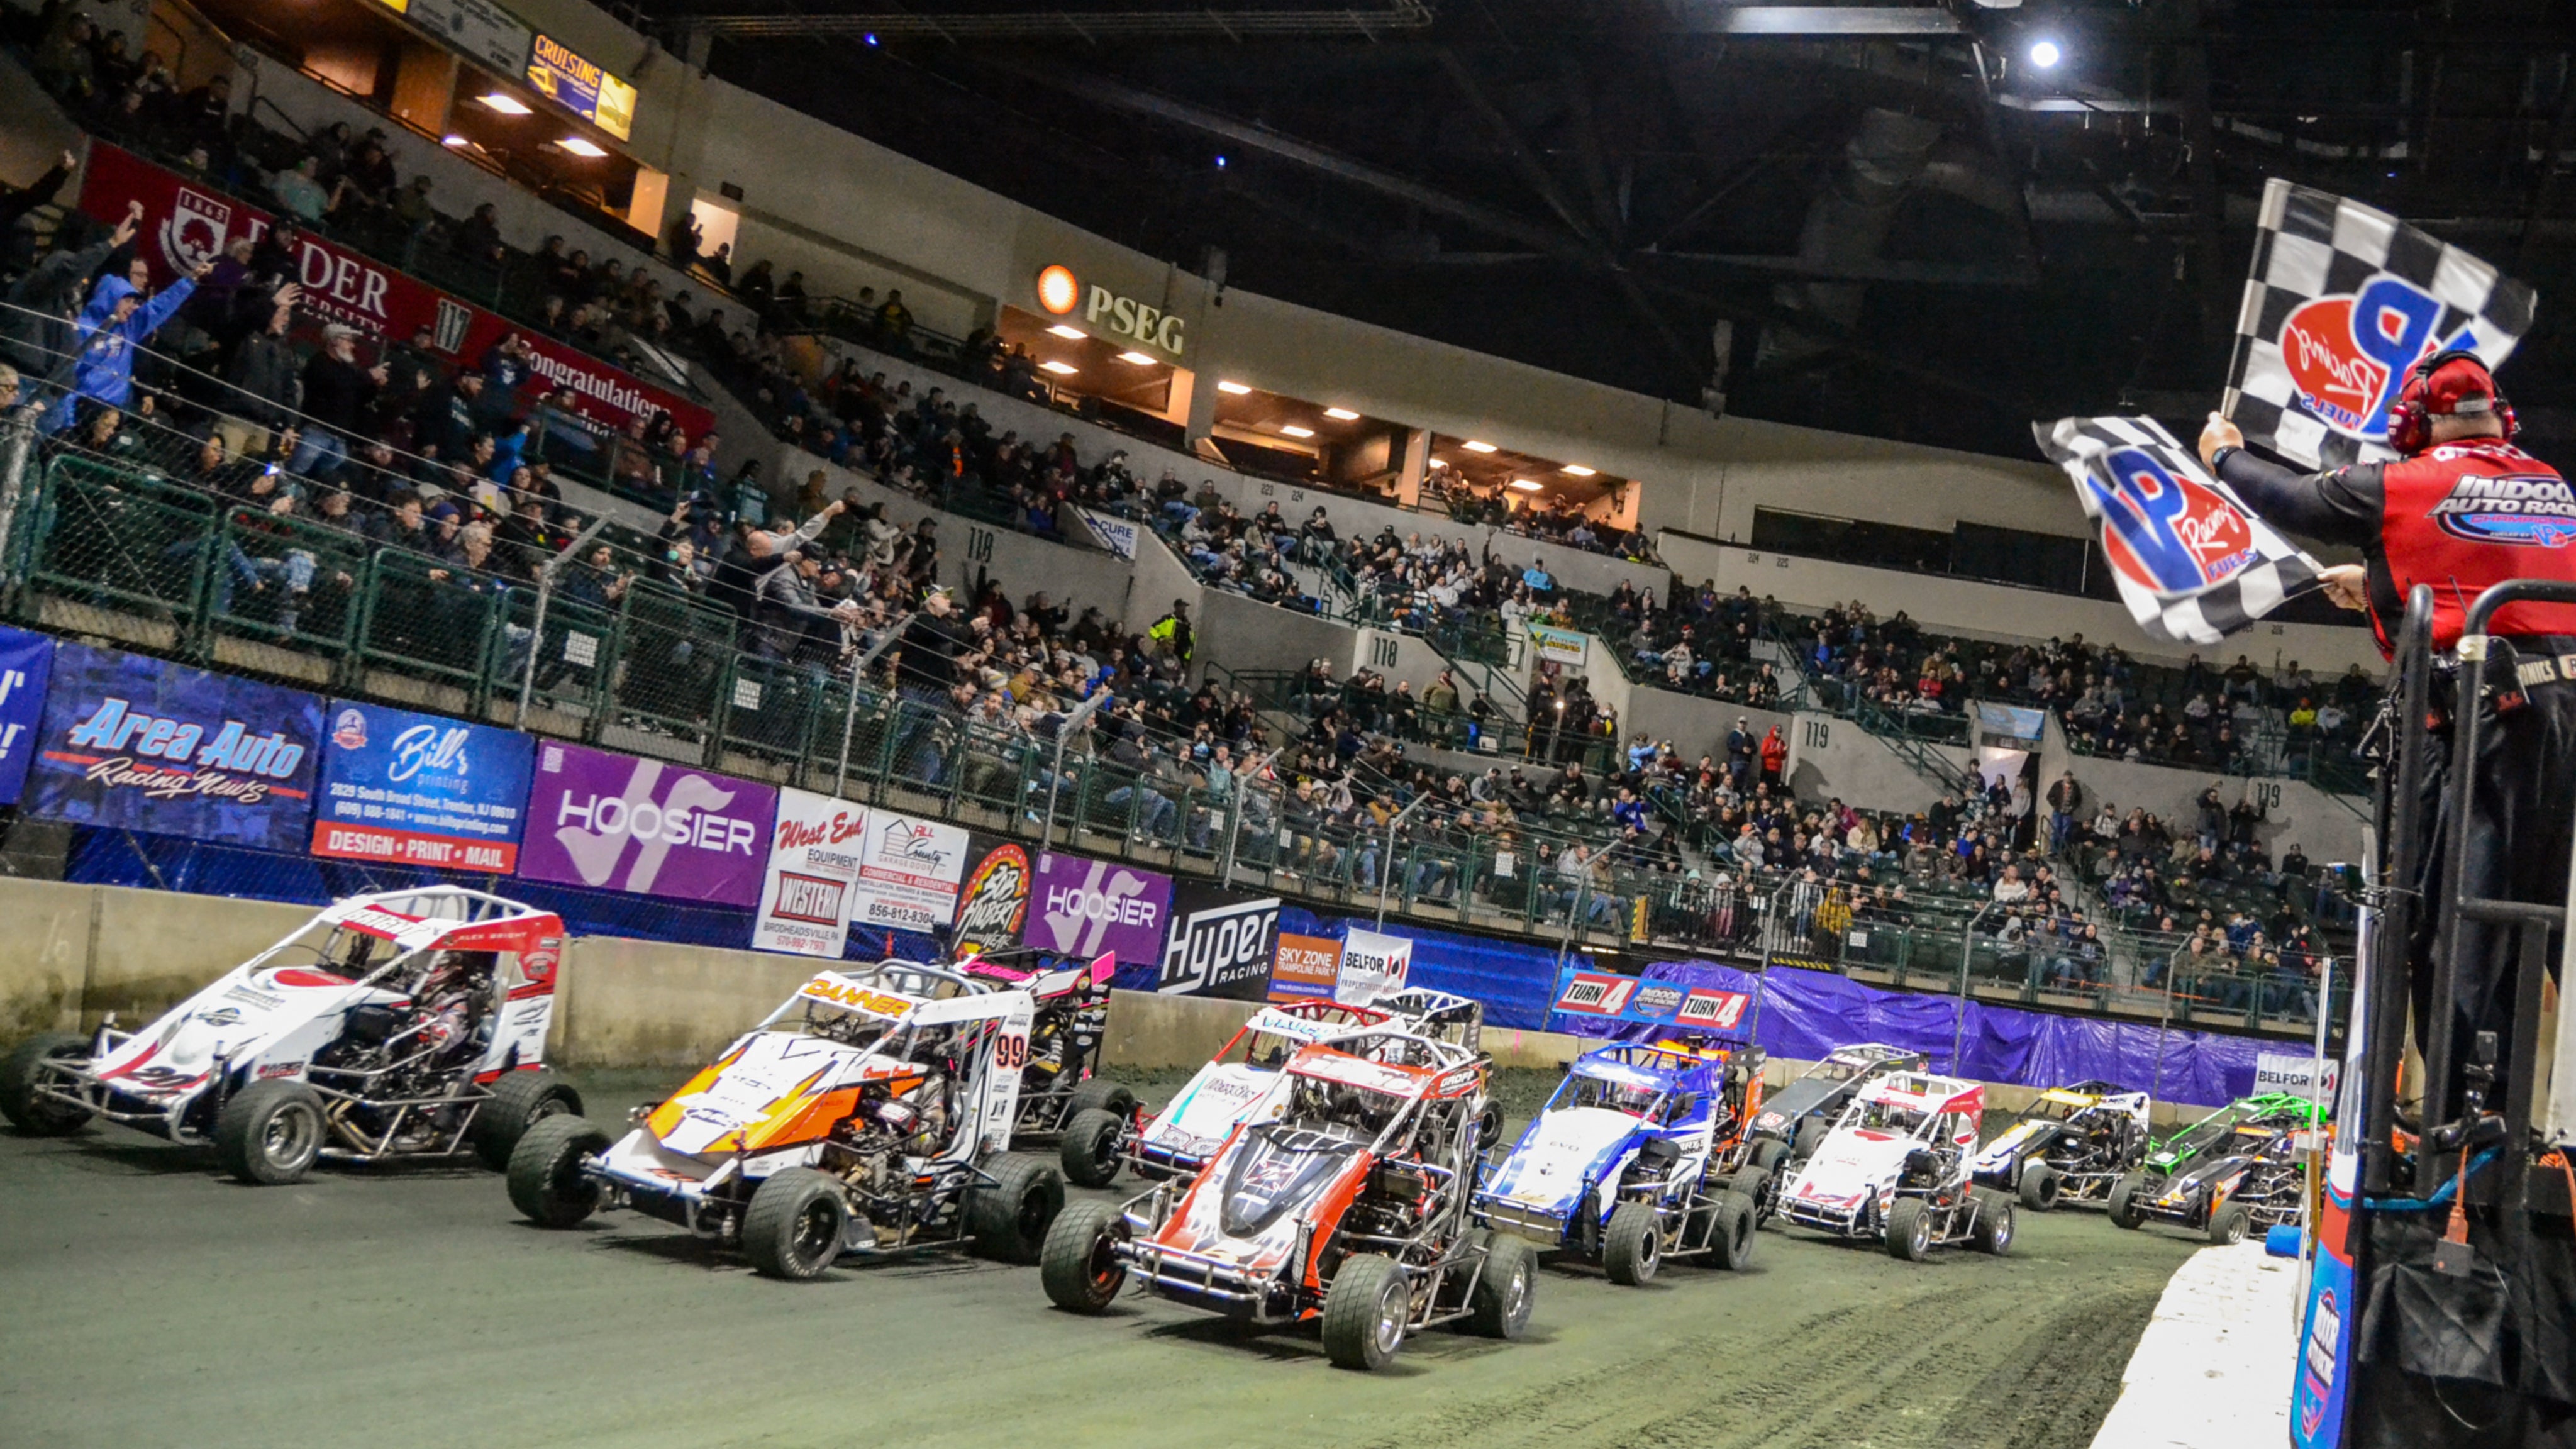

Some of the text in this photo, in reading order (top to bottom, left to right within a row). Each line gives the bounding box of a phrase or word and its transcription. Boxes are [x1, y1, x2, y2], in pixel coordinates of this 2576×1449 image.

[535, 34, 601, 88] CRUISING
[182, 192, 225, 220] 1865
[1087, 285, 1184, 355] PSEG
[1261, 483, 1304, 502] 223 224
[2428, 499, 2520, 516] AUTO
[1101, 520, 1133, 538] CURE
[2181, 502, 2240, 564] Racing
[2206, 548, 2257, 580] FUELS
[1374, 636, 1397, 668] 118
[67, 697, 204, 761] Area
[197, 720, 305, 779] Auto
[1806, 721, 1828, 748] 119
[388, 724, 469, 782] Bill's
[86, 757, 269, 804] Racing News
[417, 774, 469, 795] printing
[357, 786, 385, 802] South
[386, 791, 411, 806] Broad
[477, 804, 491, 817] NJ
[2257, 782, 2281, 809] 119
[335, 801, 362, 819] (609)
[557, 789, 756, 857] HOOSIER
[779, 811, 865, 850] West End
[913, 824, 935, 838] ALL
[328, 830, 504, 869] DESIGN PRINT MAIL
[808, 848, 858, 869] EQUIPMENT
[878, 854, 908, 868] GARAGE
[904, 837, 952, 876] County
[862, 867, 906, 884] COMMERCIAL
[914, 877, 955, 892] RESIDENTIAL
[779, 877, 843, 921] WESTERN
[1046, 884, 1157, 928] HOOSIER
[869, 904, 936, 924] 856-812-8304
[458, 931, 528, 941] ALEX BRIGHT
[1158, 897, 1282, 994] Hyper
[1277, 962, 1331, 977] TRAMPOLINE PARK
[1279, 947, 1333, 967] SKY ZONE
[1345, 952, 1385, 973] BELFOR
[1218, 961, 1268, 984] RACING
[804, 979, 912, 1019] DANNER
[1572, 979, 1635, 1014] TURN 4
[1640, 986, 1682, 999] INDOOR
[1654, 997, 1681, 1007] RACING
[1685, 994, 1747, 1028] TURN 4
[995, 1032, 1026, 1070] 99
[1441, 1068, 1475, 1088] GROFF
[2258, 1070, 2309, 1087] BELFOR
[1758, 1111, 1786, 1128] 25
